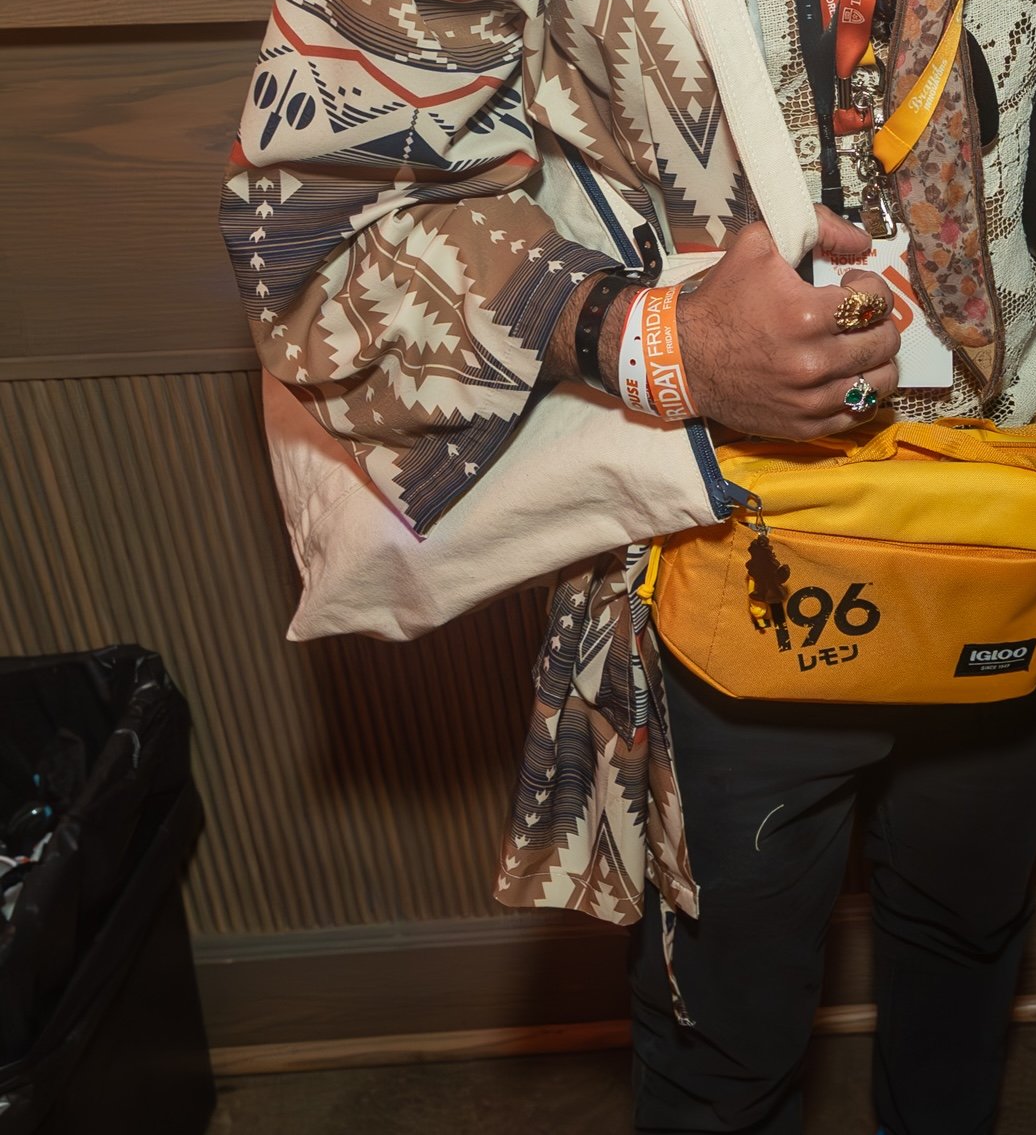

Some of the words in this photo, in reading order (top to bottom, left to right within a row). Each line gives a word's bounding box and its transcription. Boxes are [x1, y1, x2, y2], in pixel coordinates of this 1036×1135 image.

[830, 254, 868, 266] HOUSE
[646, 296, 664, 358] FRIDAY
[664, 325, 673, 354] FRIDAY
[625, 378, 644, 410] OUSE
[797, 644, 859, 672] レモン
[969, 646, 1028, 662] IGLOO
